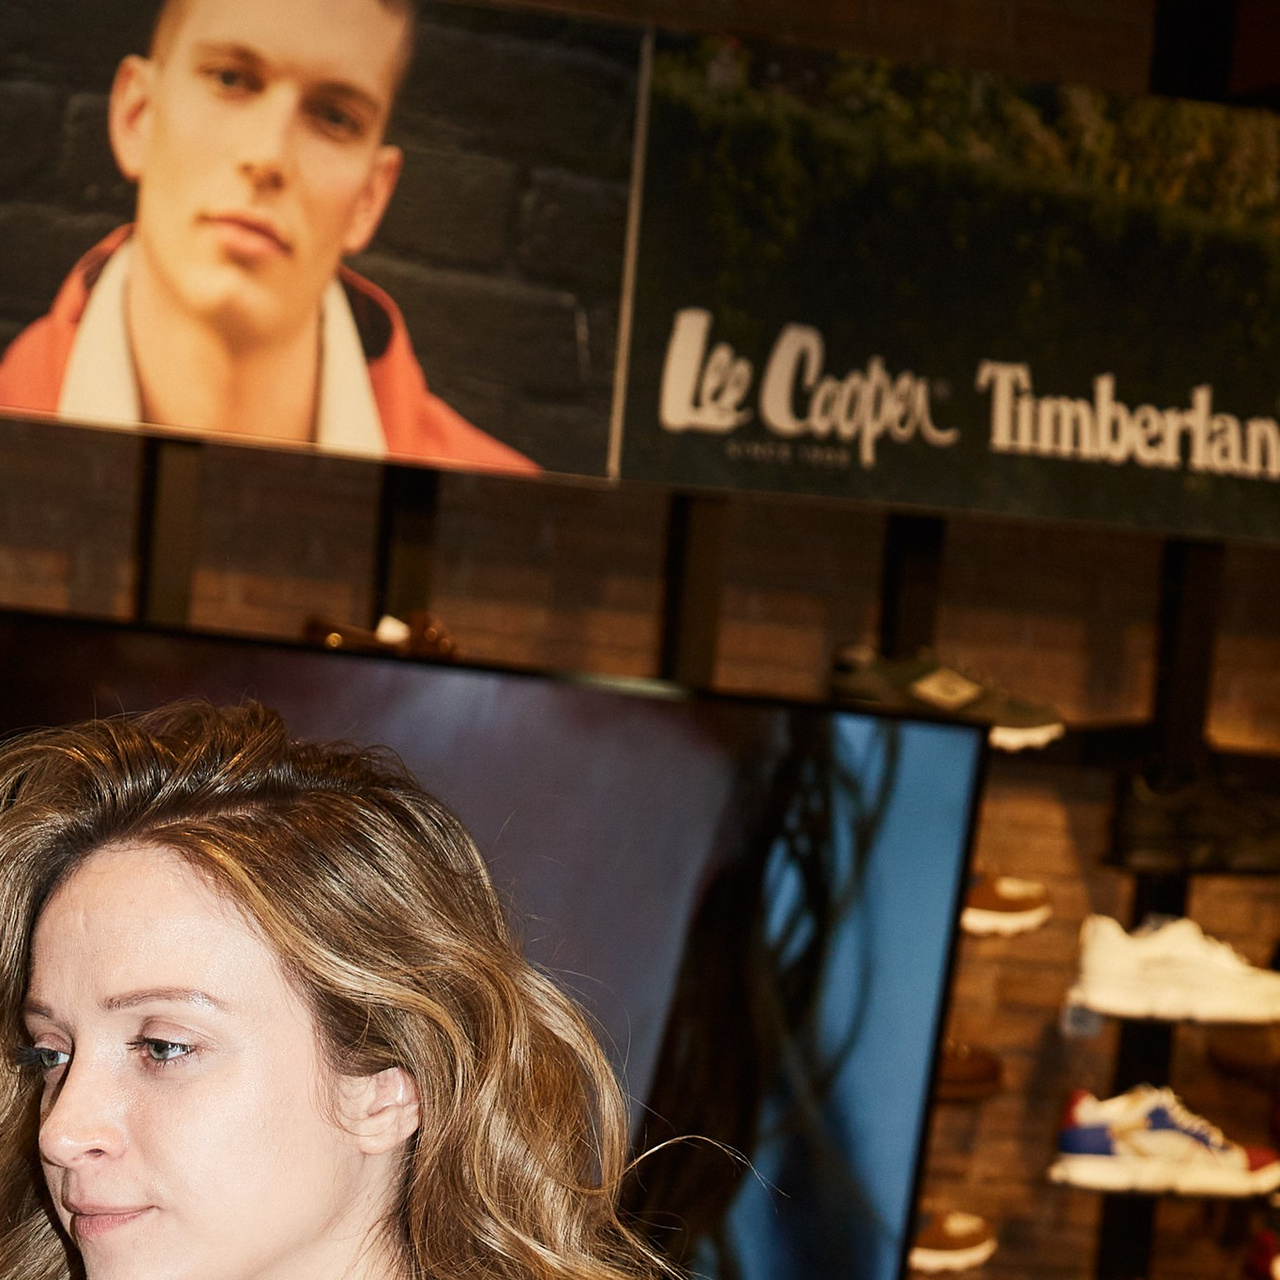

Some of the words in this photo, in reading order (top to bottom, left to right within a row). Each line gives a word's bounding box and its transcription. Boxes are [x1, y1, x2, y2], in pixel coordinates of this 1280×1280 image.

[658, 307, 754, 433] Le
[760, 321, 962, 470] Cooper
[976, 358, 1280, 483] Timberlan
